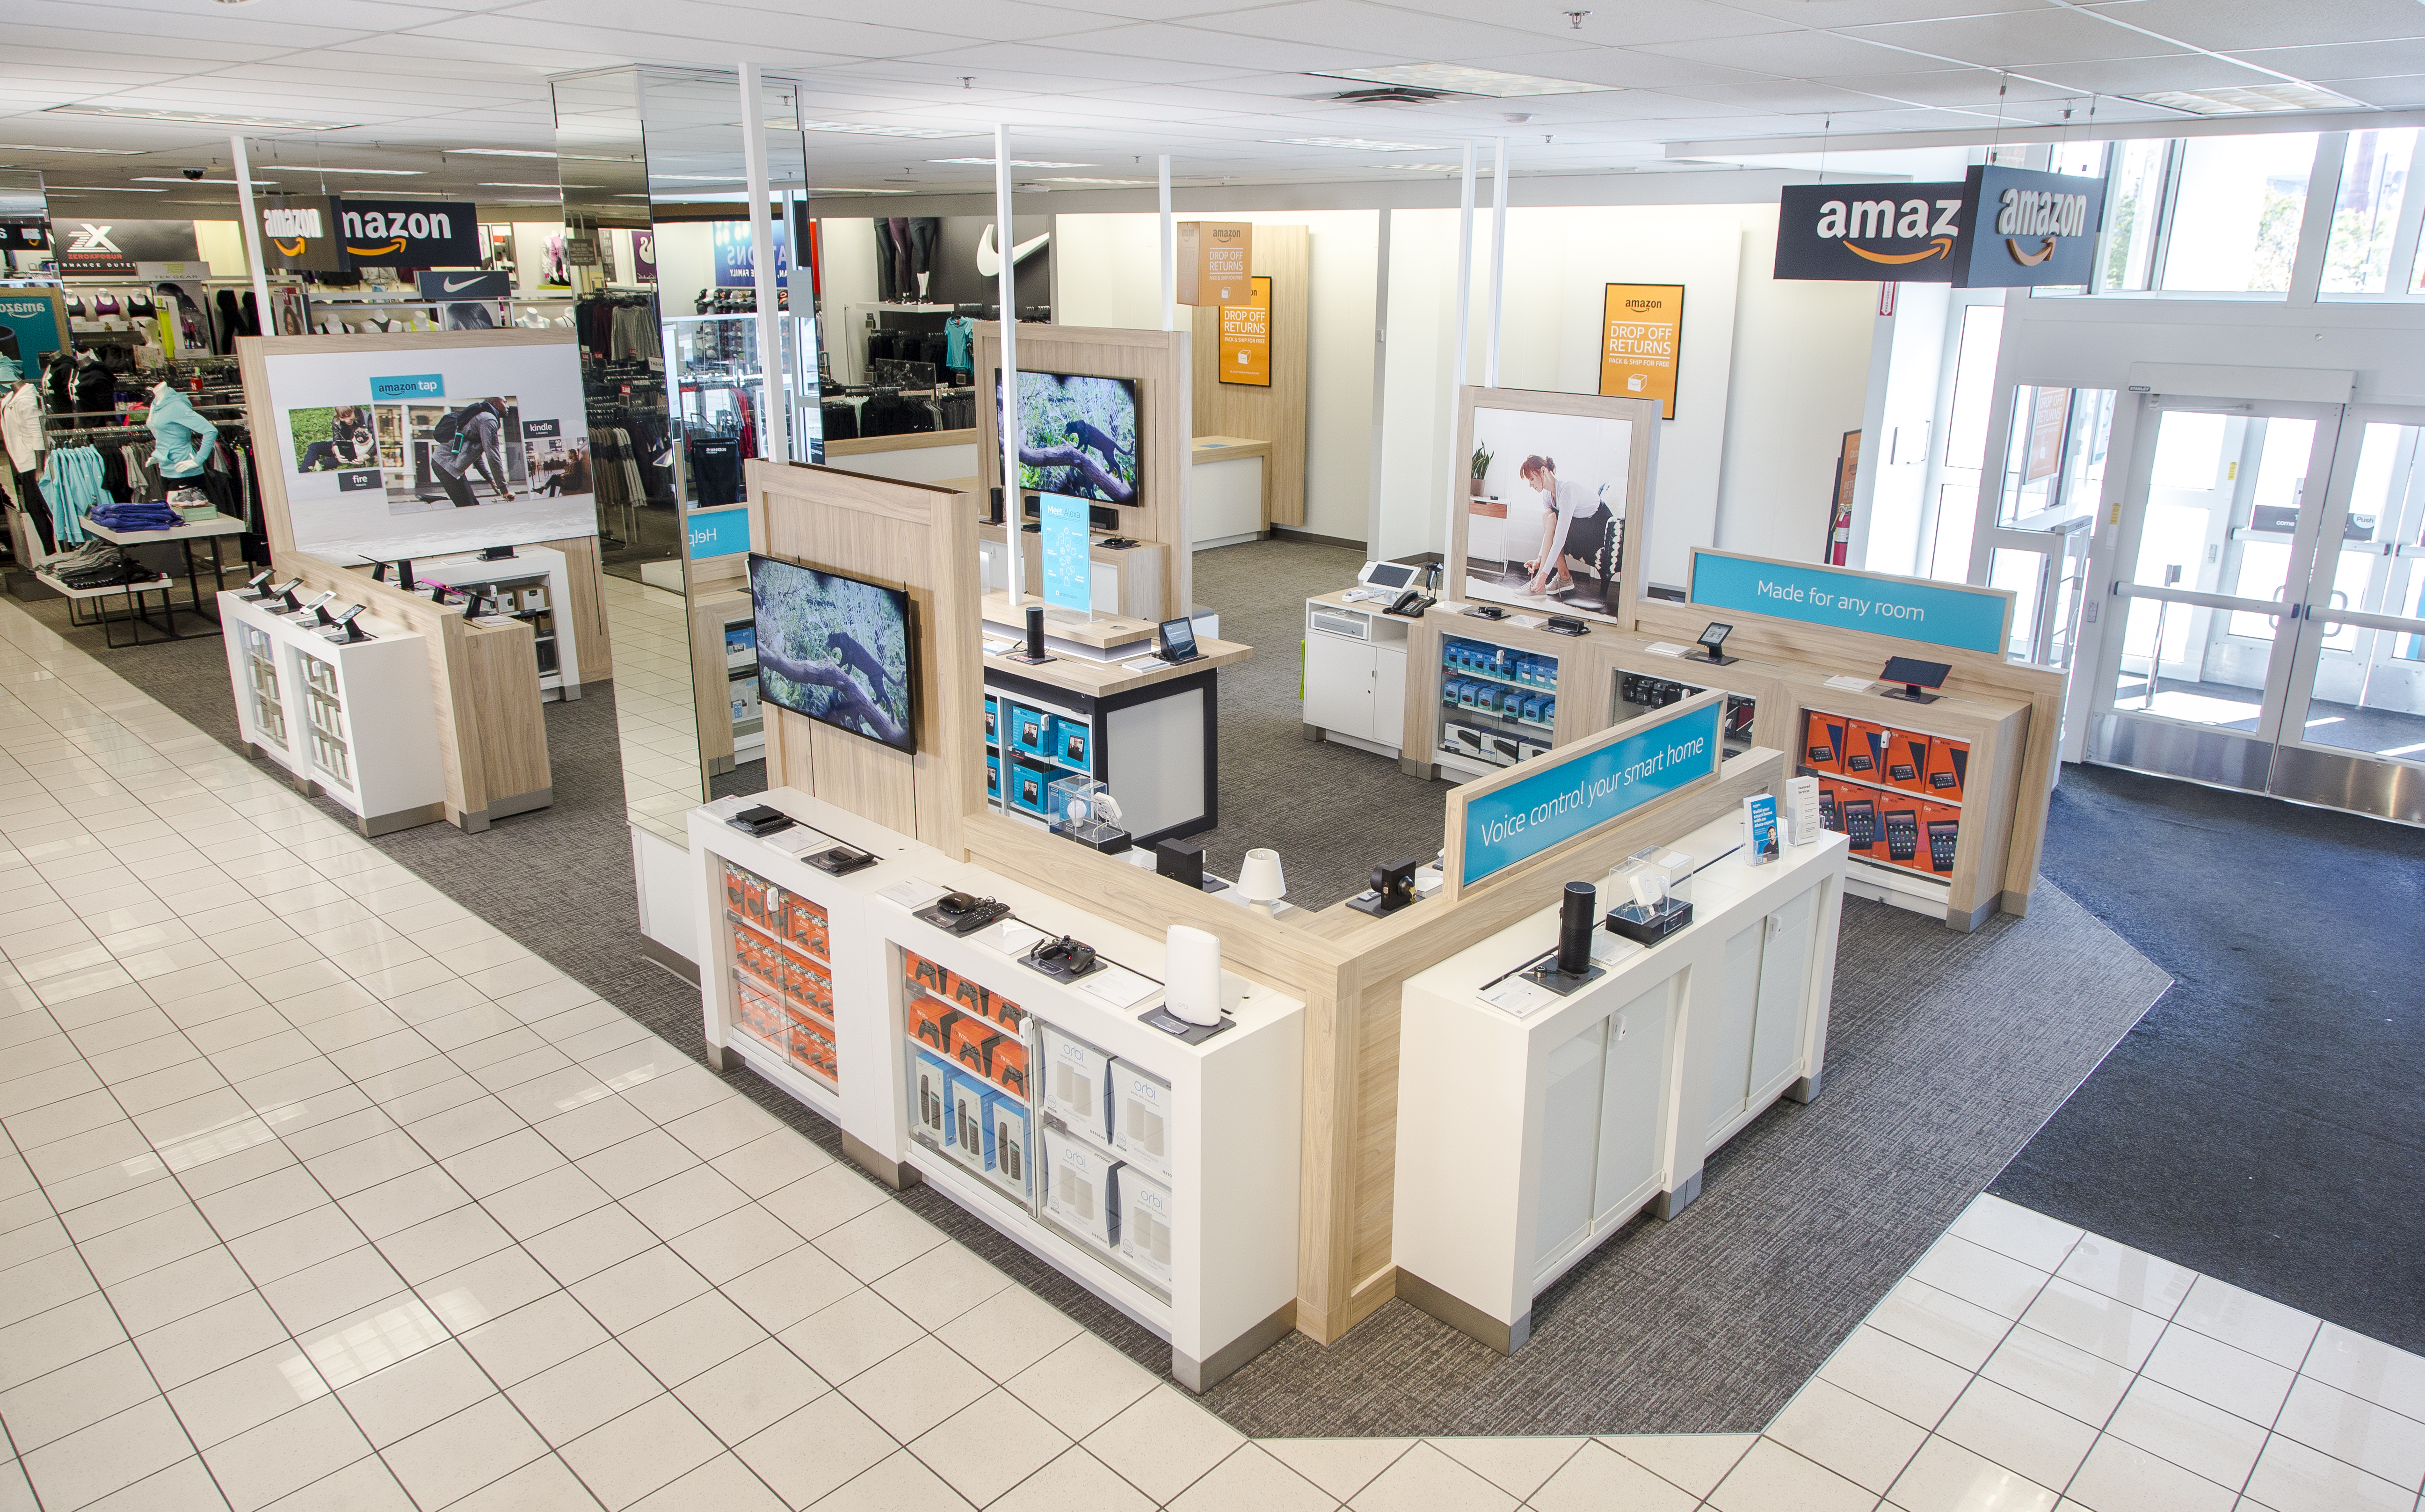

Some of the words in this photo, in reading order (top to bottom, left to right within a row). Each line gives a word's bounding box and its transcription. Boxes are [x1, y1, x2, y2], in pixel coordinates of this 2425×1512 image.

[1999, 188, 2087, 236] amazon
[263, 209, 321, 237] amazon
[1213, 229, 1241, 238] amazon
[1210, 251, 1228, 260] DROP
[1230, 251, 1243, 260] OFF
[1210, 261, 1243, 271] RETURNS
[1626, 299, 1662, 308] amazon
[1225, 311, 1247, 321] DROP
[1249, 312, 1265, 322] OFF
[1225, 321, 1265, 334] RETURNS
[1611, 326, 1644, 338] DROP
[1648, 327, 1672, 340] OFF
[1609, 339, 1671, 355] RETURNS
[378, 383, 416, 393] amazon
[418, 380, 437, 393] tap
[2040, 395, 2052, 409] DROP
[2053, 394, 2063, 406] OFF
[2037, 407, 2062, 423] RETURNS
[530, 423, 552, 432] kindle
[352, 474, 368, 484] fire
[1047, 505, 1062, 516] Meet
[1064, 508, 1080, 518] Alexa
[1758, 581, 1803, 603] Made
[1809, 587, 1834, 606] for
[1838, 596, 1870, 617] any
[1875, 602, 1924, 621] room
[1482, 812, 1525, 846] Voice
[1530, 781, 1584, 826] control
[1588, 772, 1621, 807] your
[1624, 753, 1663, 786] smart
[1667, 737, 1704, 764] home
[1063, 1044, 1083, 1062] orbi
[1092, 1047, 1109, 1057] NETGEAR
[1134, 1081, 1155, 1100] orbi
[1090, 1129, 1106, 1141] NETGEAR
[1065, 1149, 1085, 1168] orbi
[1094, 1153, 1111, 1163] NETGEAR
[1141, 1191, 1162, 1210] orbi
[1092, 1232, 1107, 1244] NETGEAR
